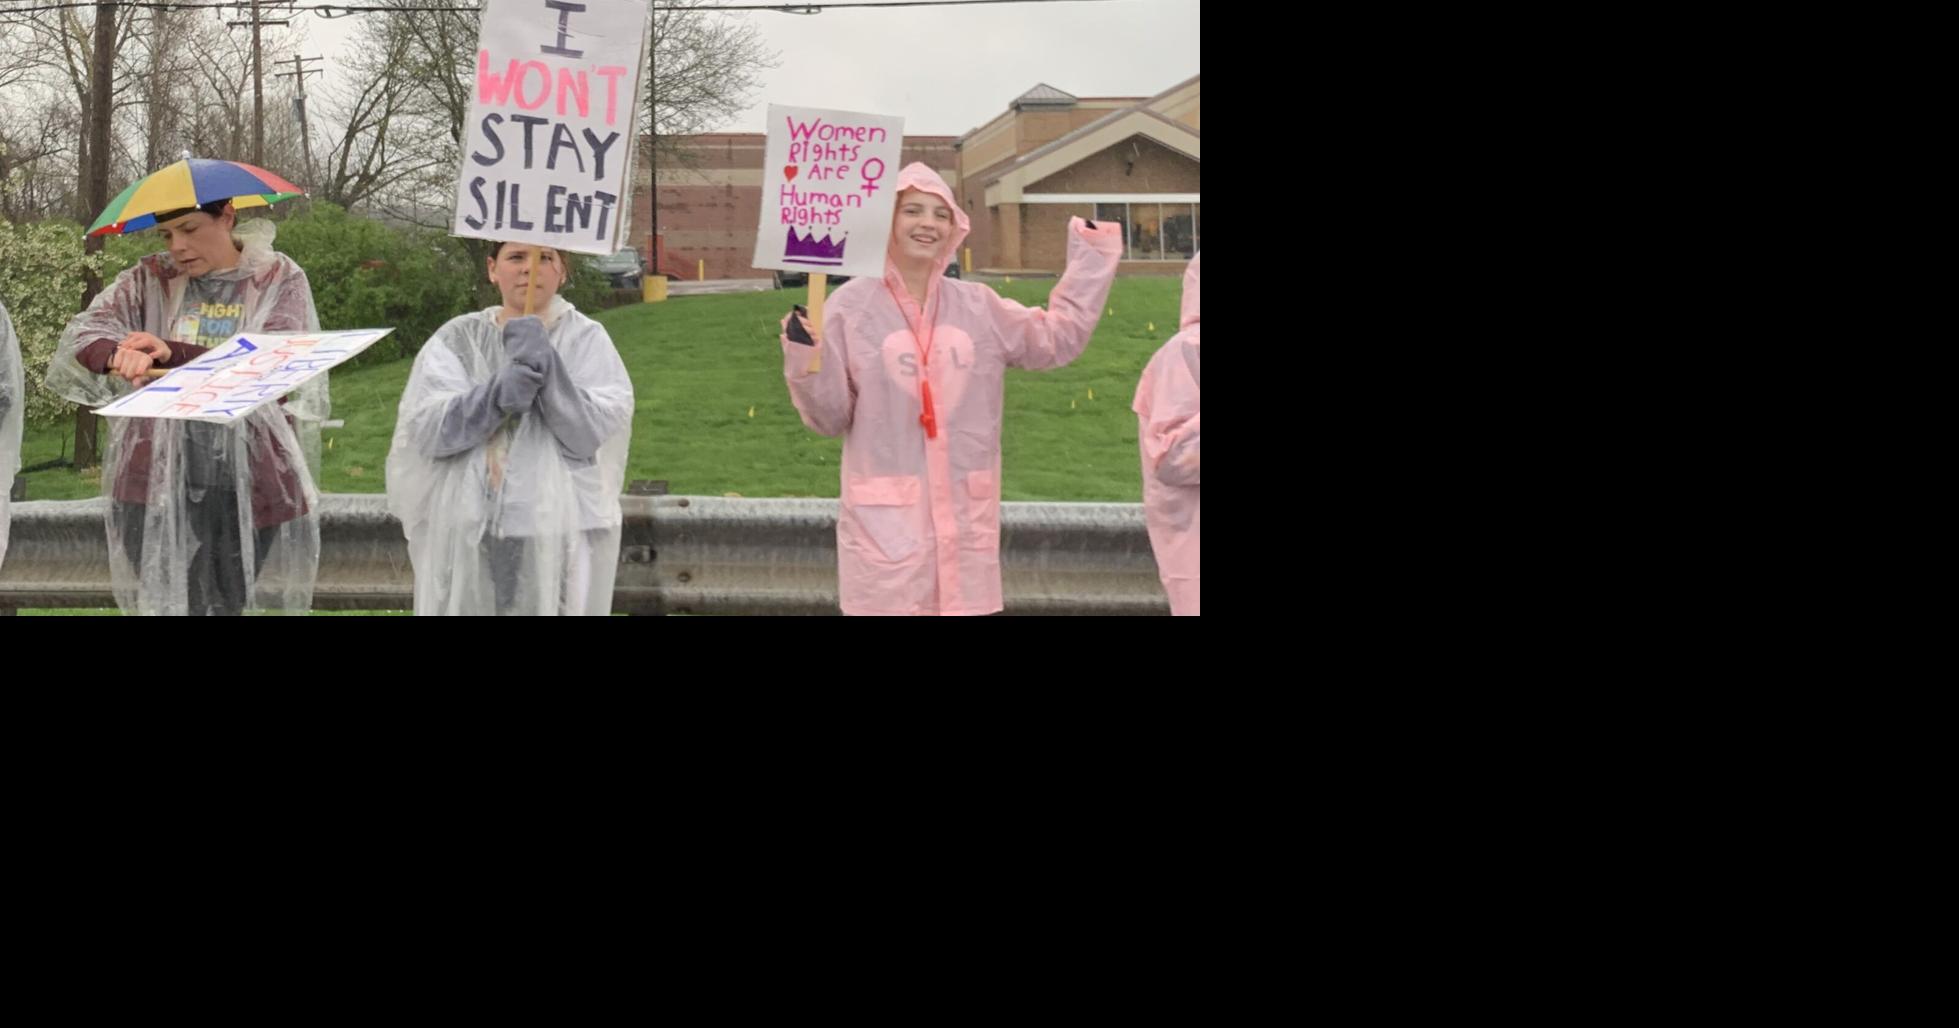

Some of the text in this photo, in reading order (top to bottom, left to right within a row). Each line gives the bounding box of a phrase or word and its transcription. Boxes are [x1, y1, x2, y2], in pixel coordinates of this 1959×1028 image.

[541, 1, 586, 58] I
[478, 49, 627, 126] WON'T
[471, 113, 620, 181] STAY
[787, 116, 886, 143] Women
[780, 184, 861, 207] Human
[808, 164, 849, 180] Are
[465, 177, 616, 240] SILENT
[201, 319, 236, 334] FOR
[115, 337, 258, 408] ALL
